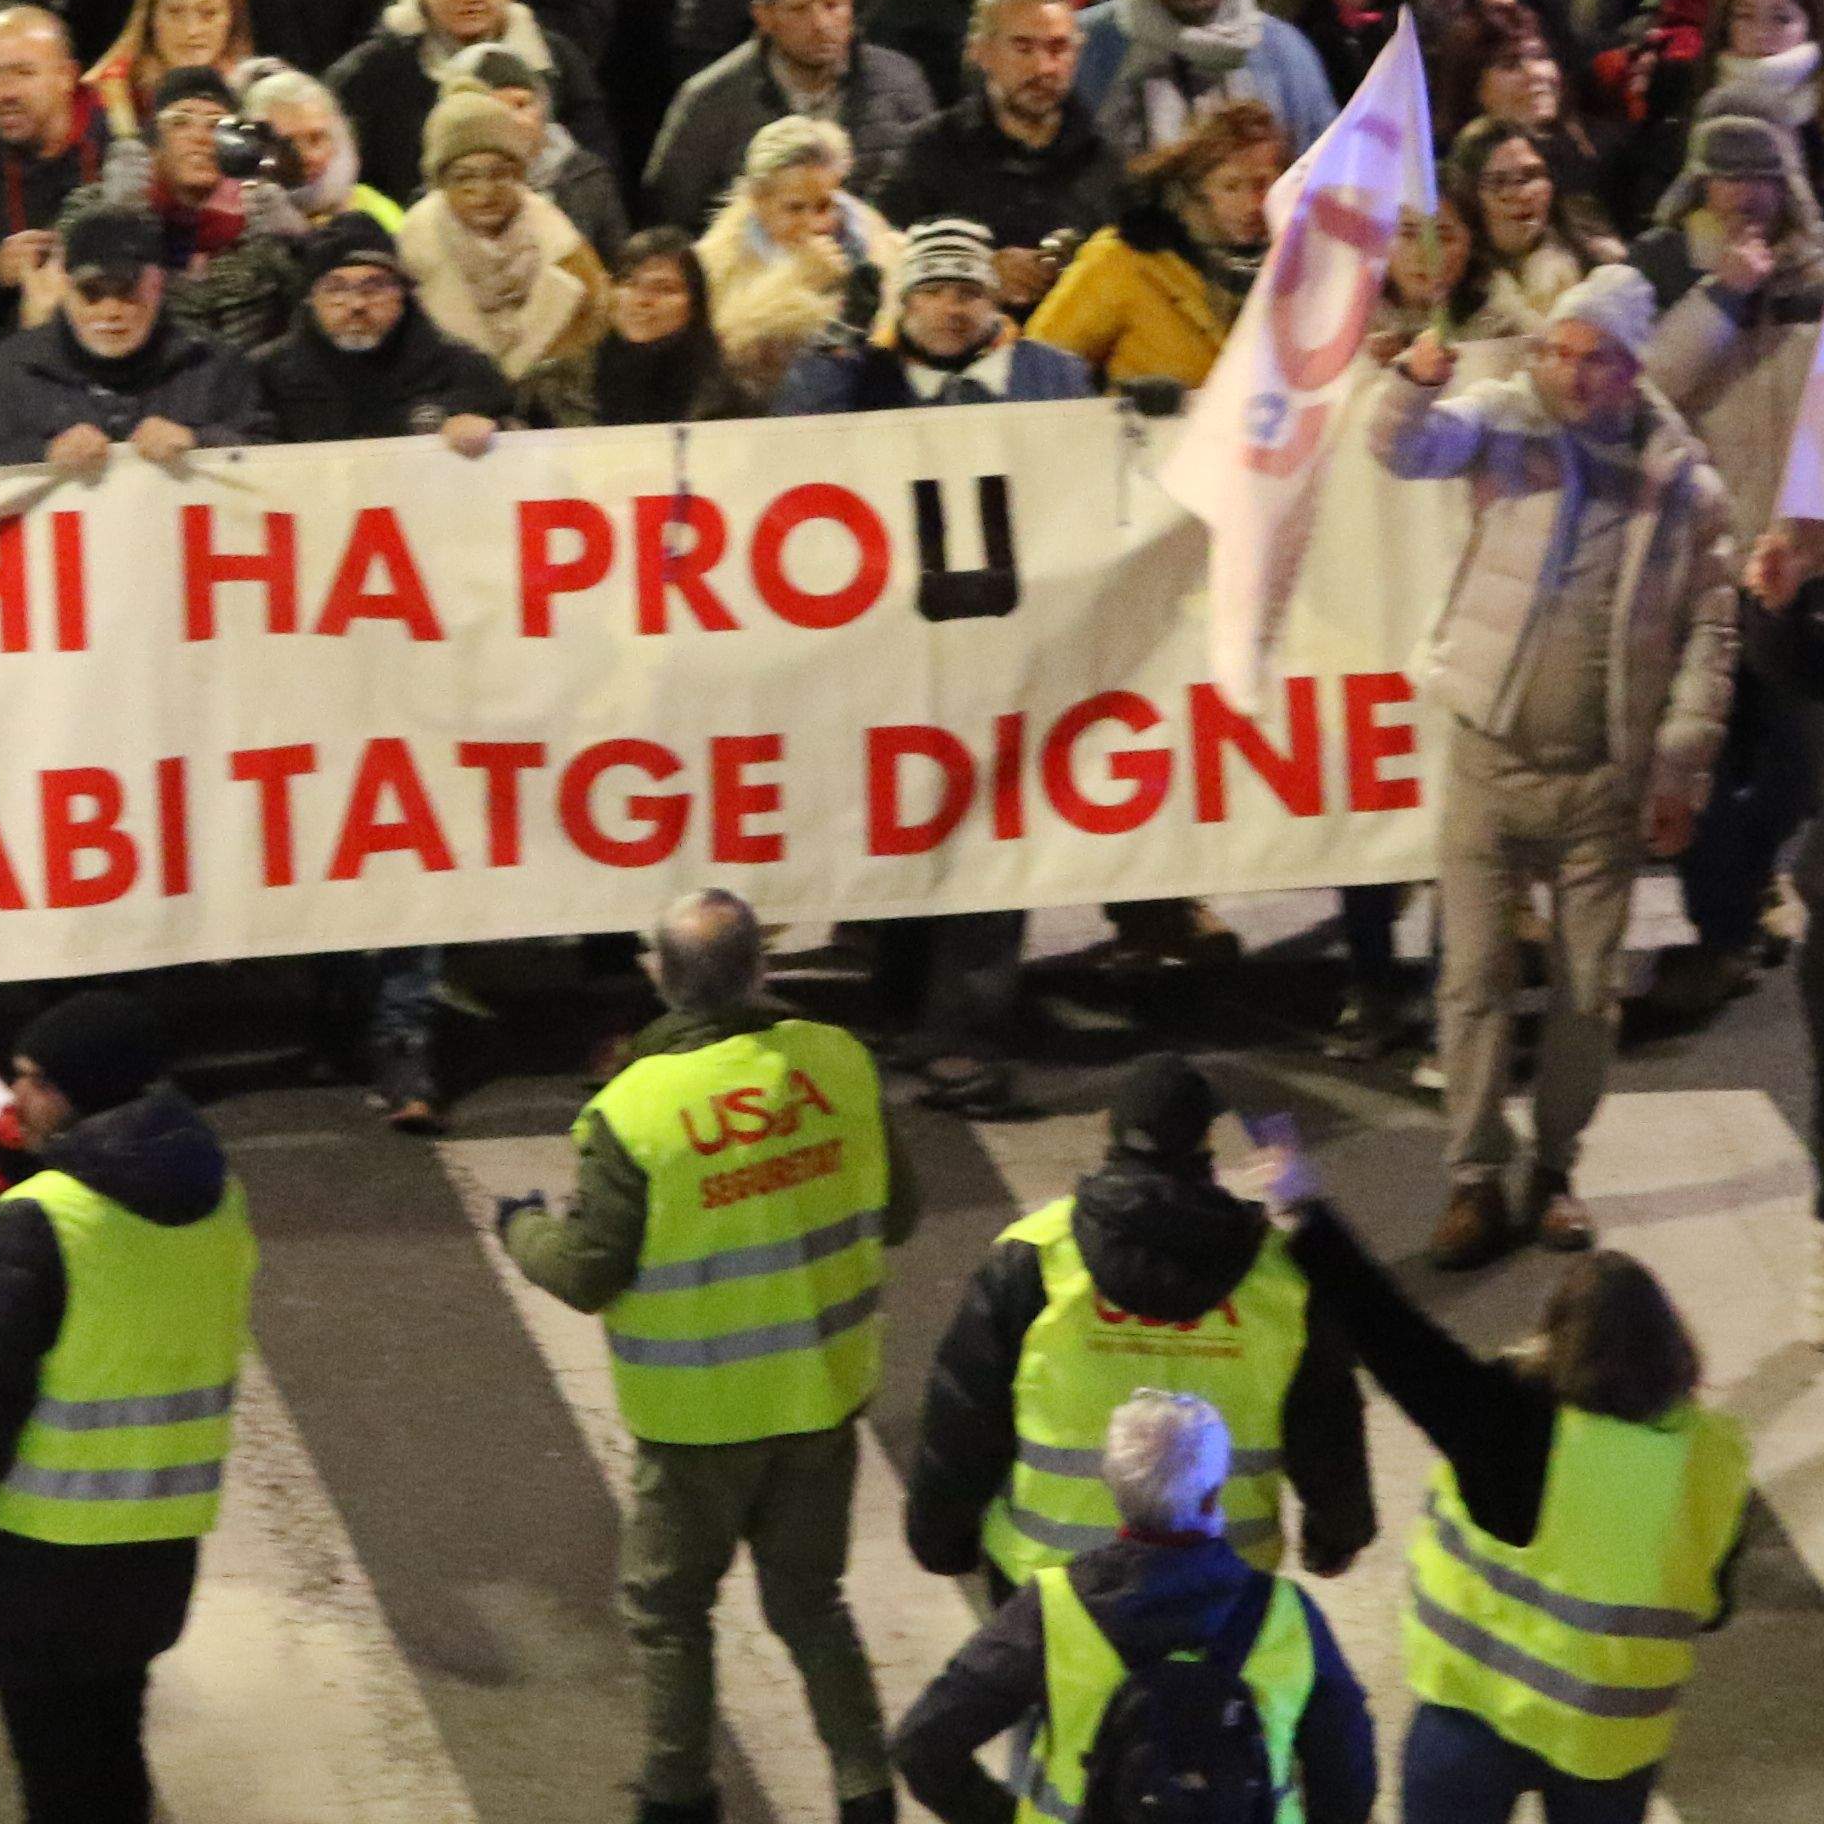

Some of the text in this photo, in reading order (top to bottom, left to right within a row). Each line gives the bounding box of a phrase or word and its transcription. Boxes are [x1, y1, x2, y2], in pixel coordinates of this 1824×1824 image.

[180, 503, 445, 643] HA
[515, 474, 1020, 639] PROU
[865, 671, 1423, 857] DIGNE
